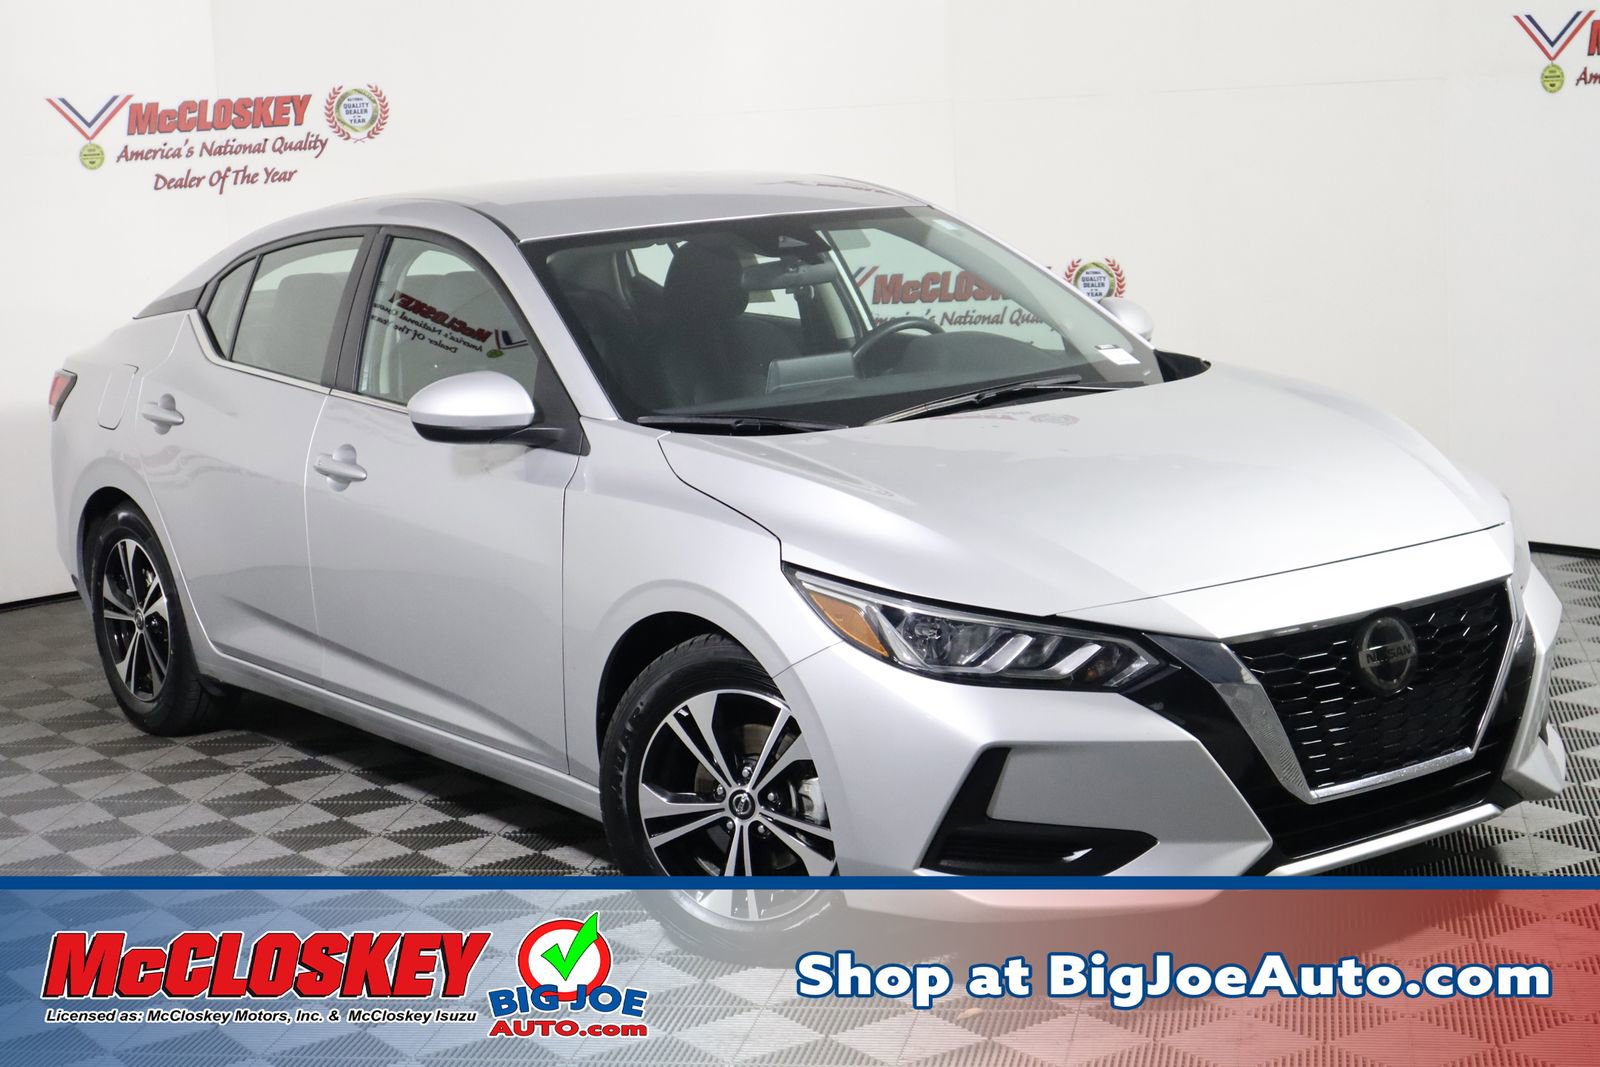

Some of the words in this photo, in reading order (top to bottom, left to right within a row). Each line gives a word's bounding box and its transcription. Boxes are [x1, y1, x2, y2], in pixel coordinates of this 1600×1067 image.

[127, 94, 312, 136] McCLOSKEY
[116, 139, 194, 163] America's
[200, 138, 266, 158] National
[272, 132, 328, 158] Quality
[153, 168, 205, 191] Dealer
[208, 166, 232, 195] Of
[232, 165, 260, 187] The
[264, 167, 298, 185] Year
[872, 271, 1010, 305] McCLOS
[940, 306, 1008, 326] National
[1366, 643, 1411, 664] NSAN
